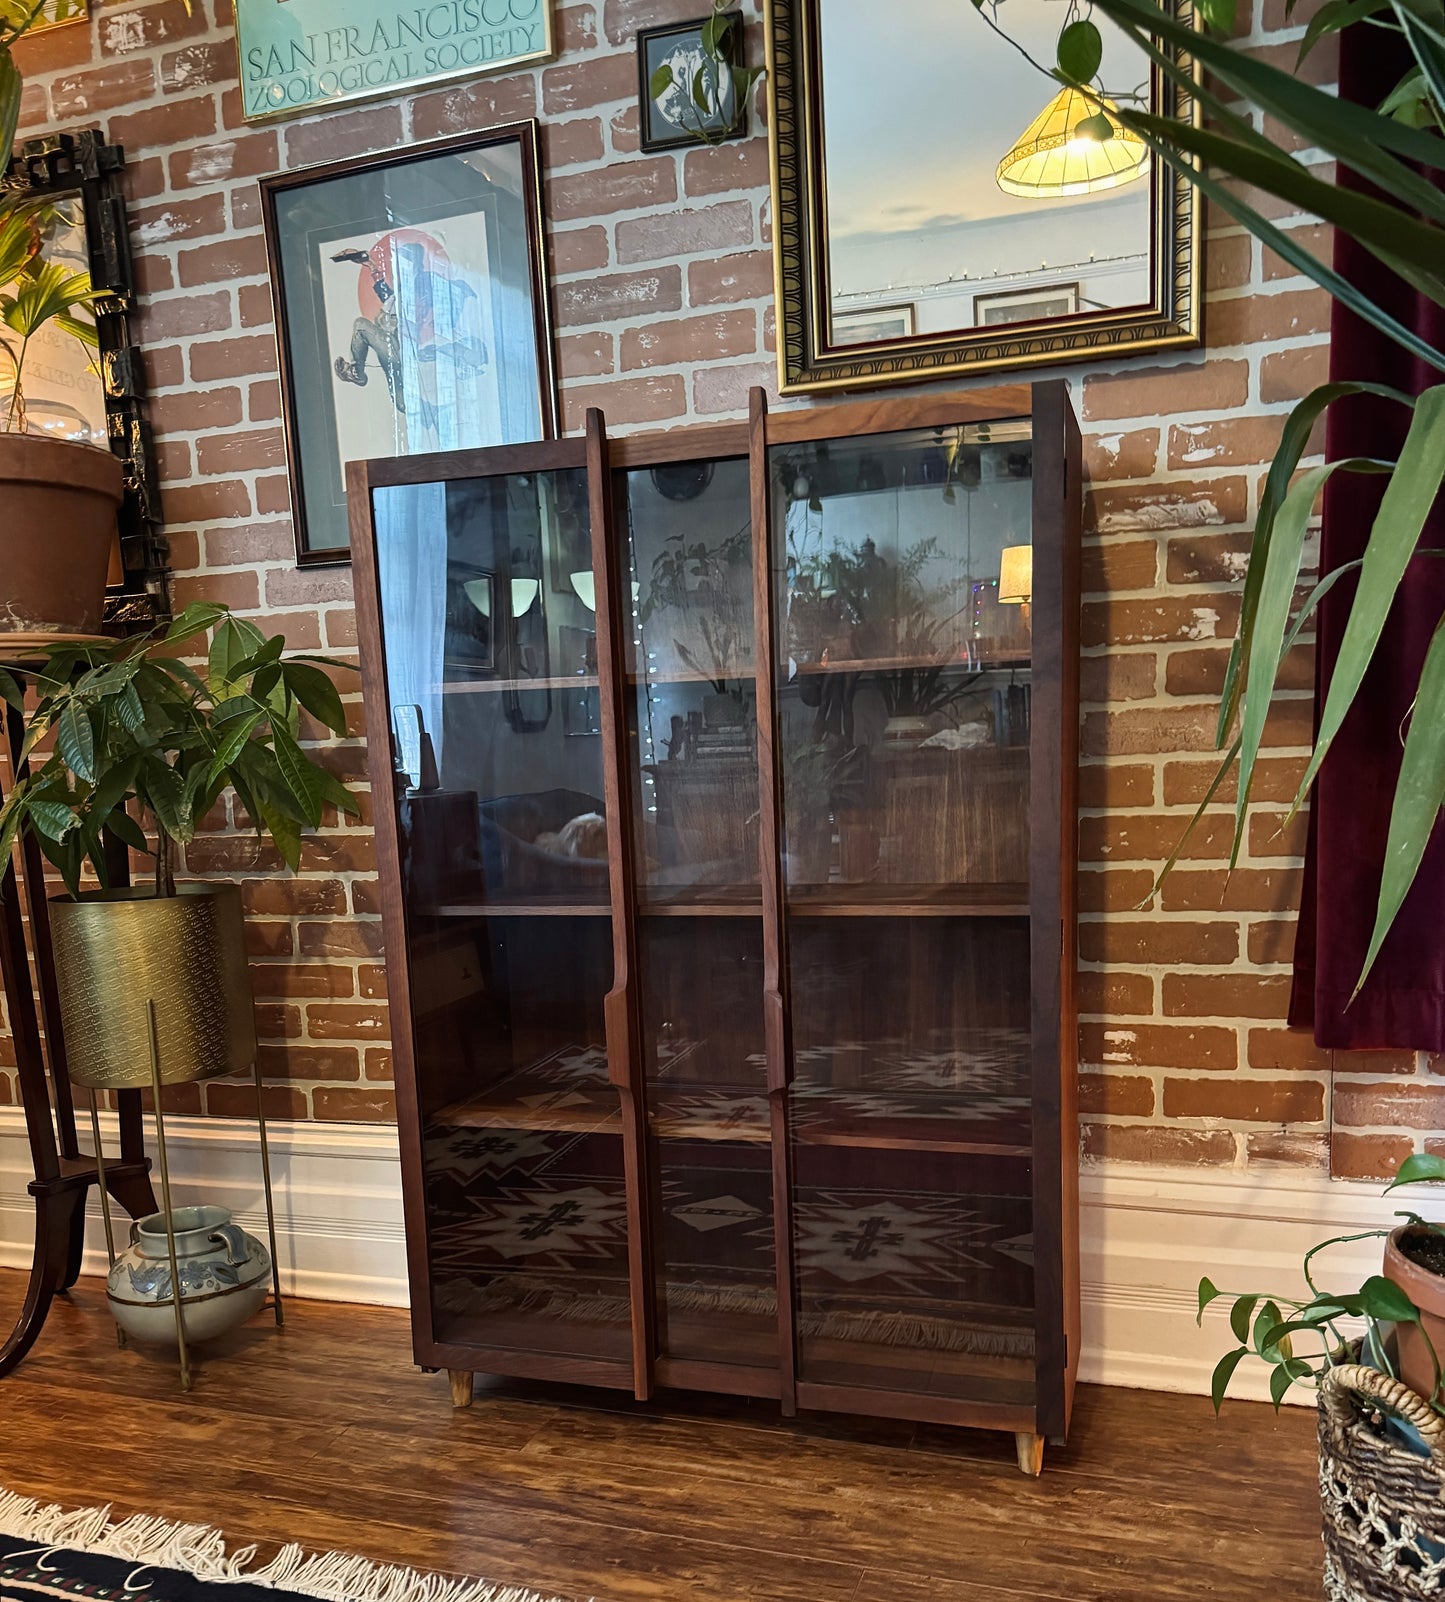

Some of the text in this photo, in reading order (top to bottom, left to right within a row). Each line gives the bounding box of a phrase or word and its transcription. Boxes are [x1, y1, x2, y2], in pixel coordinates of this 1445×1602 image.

[248, 0, 538, 81] SAN FRANCISCO
[250, 23, 540, 111] ZOOLOGICAL SOCIETY
